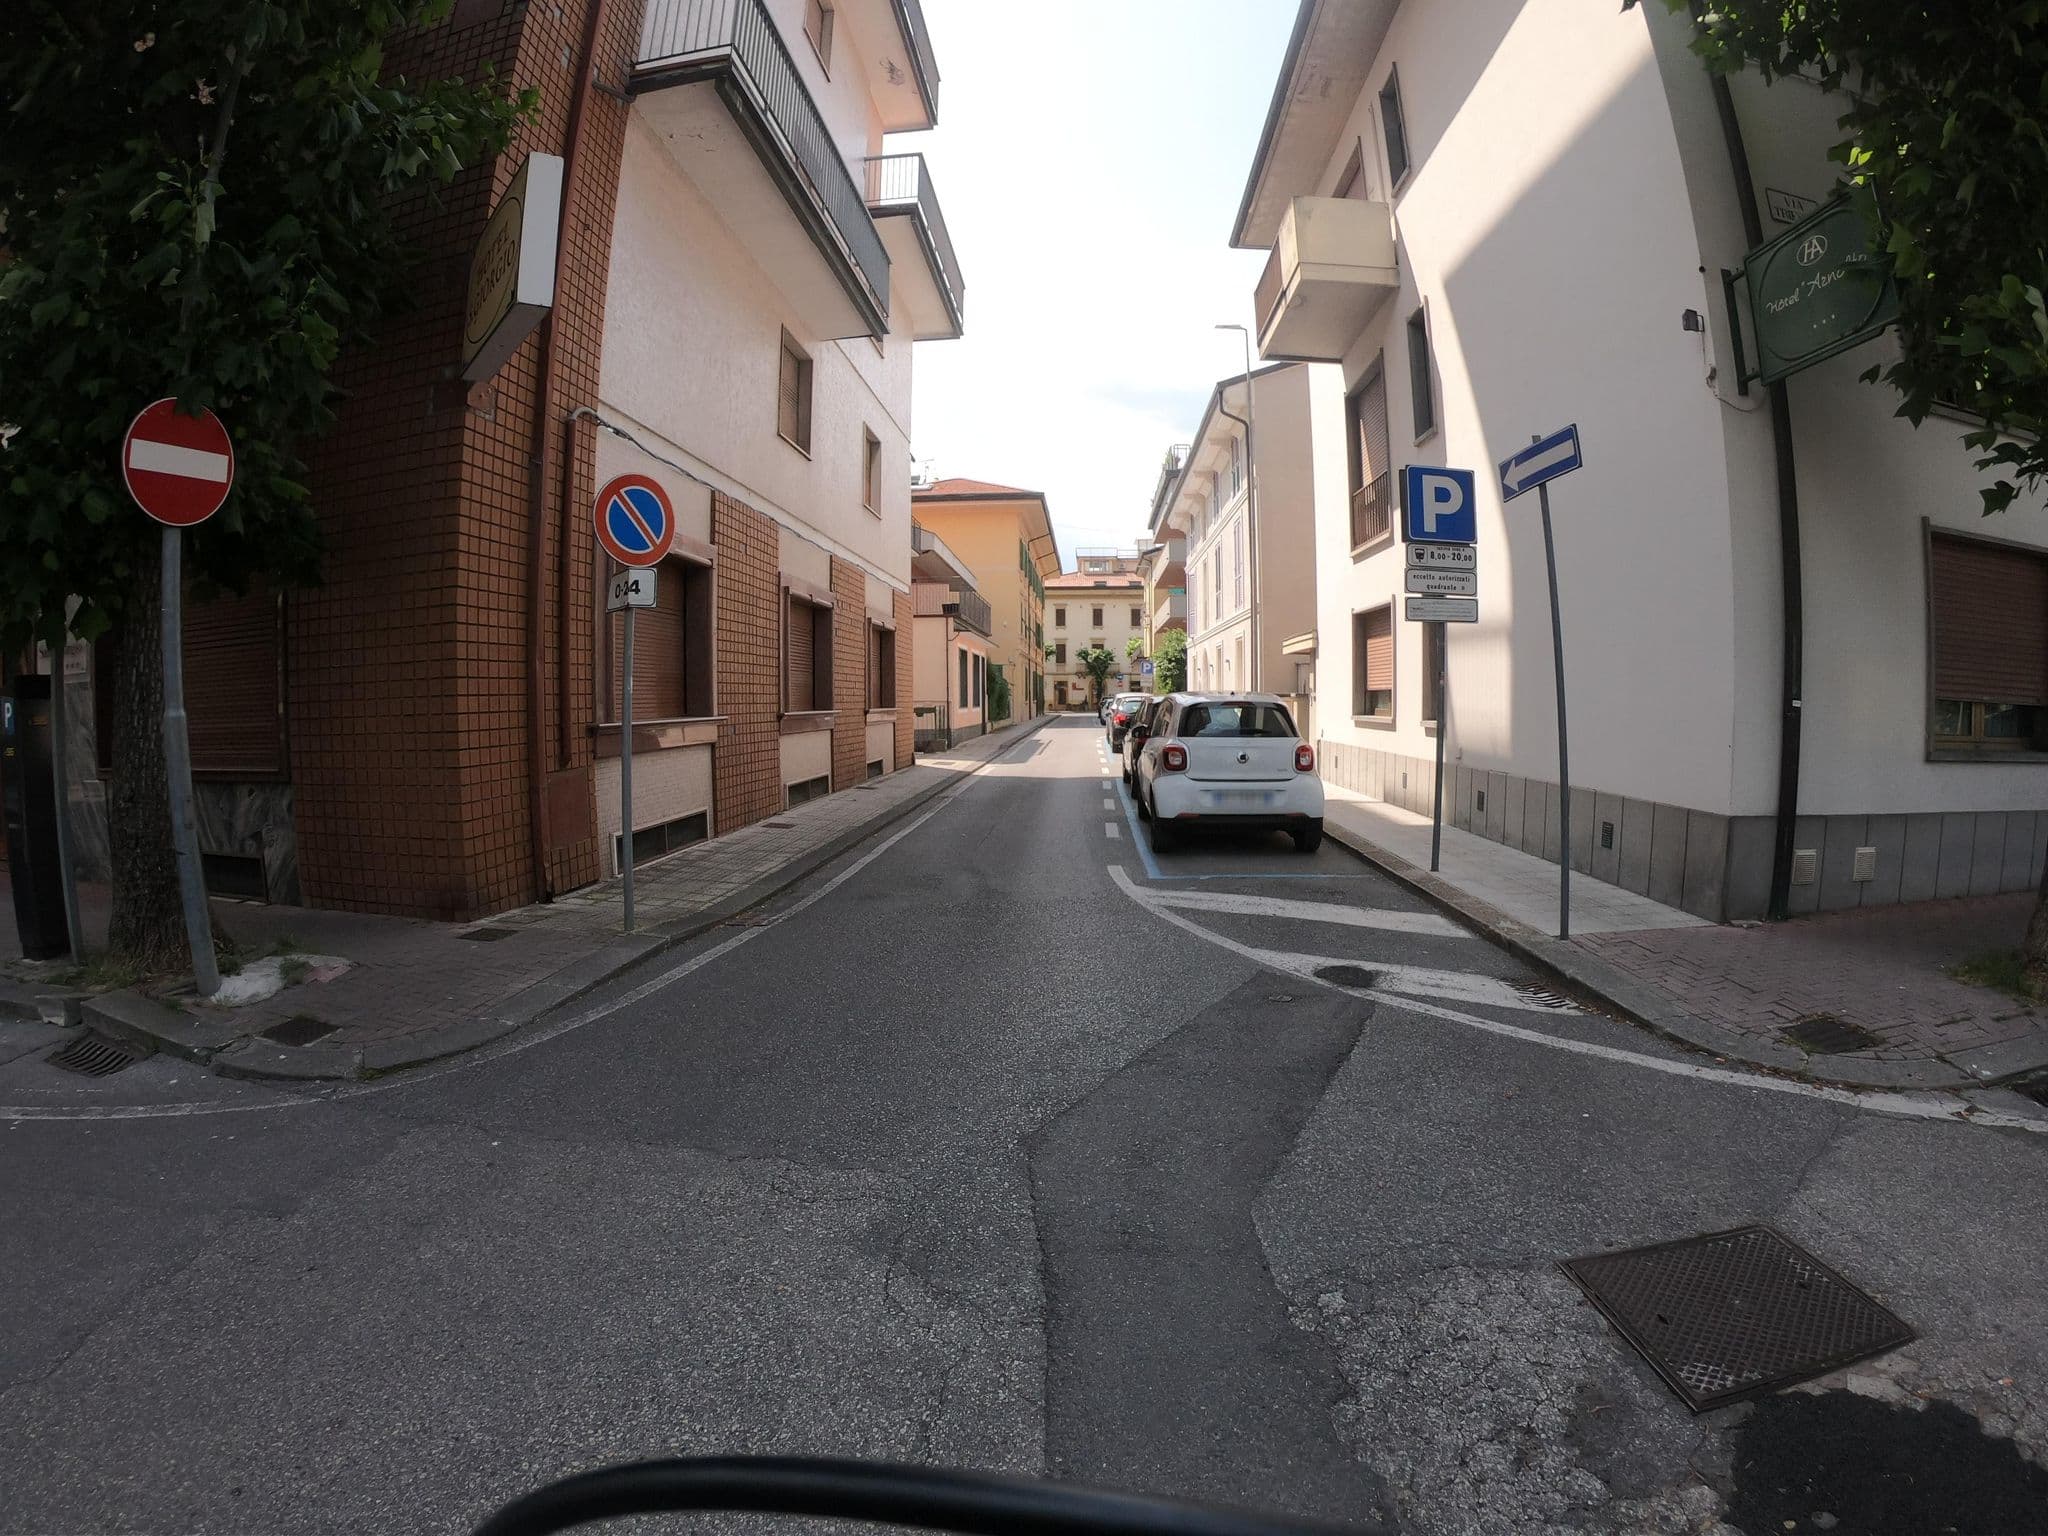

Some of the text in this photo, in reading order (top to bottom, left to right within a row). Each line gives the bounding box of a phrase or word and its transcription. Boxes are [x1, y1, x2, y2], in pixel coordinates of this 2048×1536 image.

[1783, 195, 1804, 212] VIA
[477, 220, 510, 282] HOTEL
[1422, 474, 1464, 533] P
[1142, 662, 1152, 673] P
[4, 702, 12, 728] P
